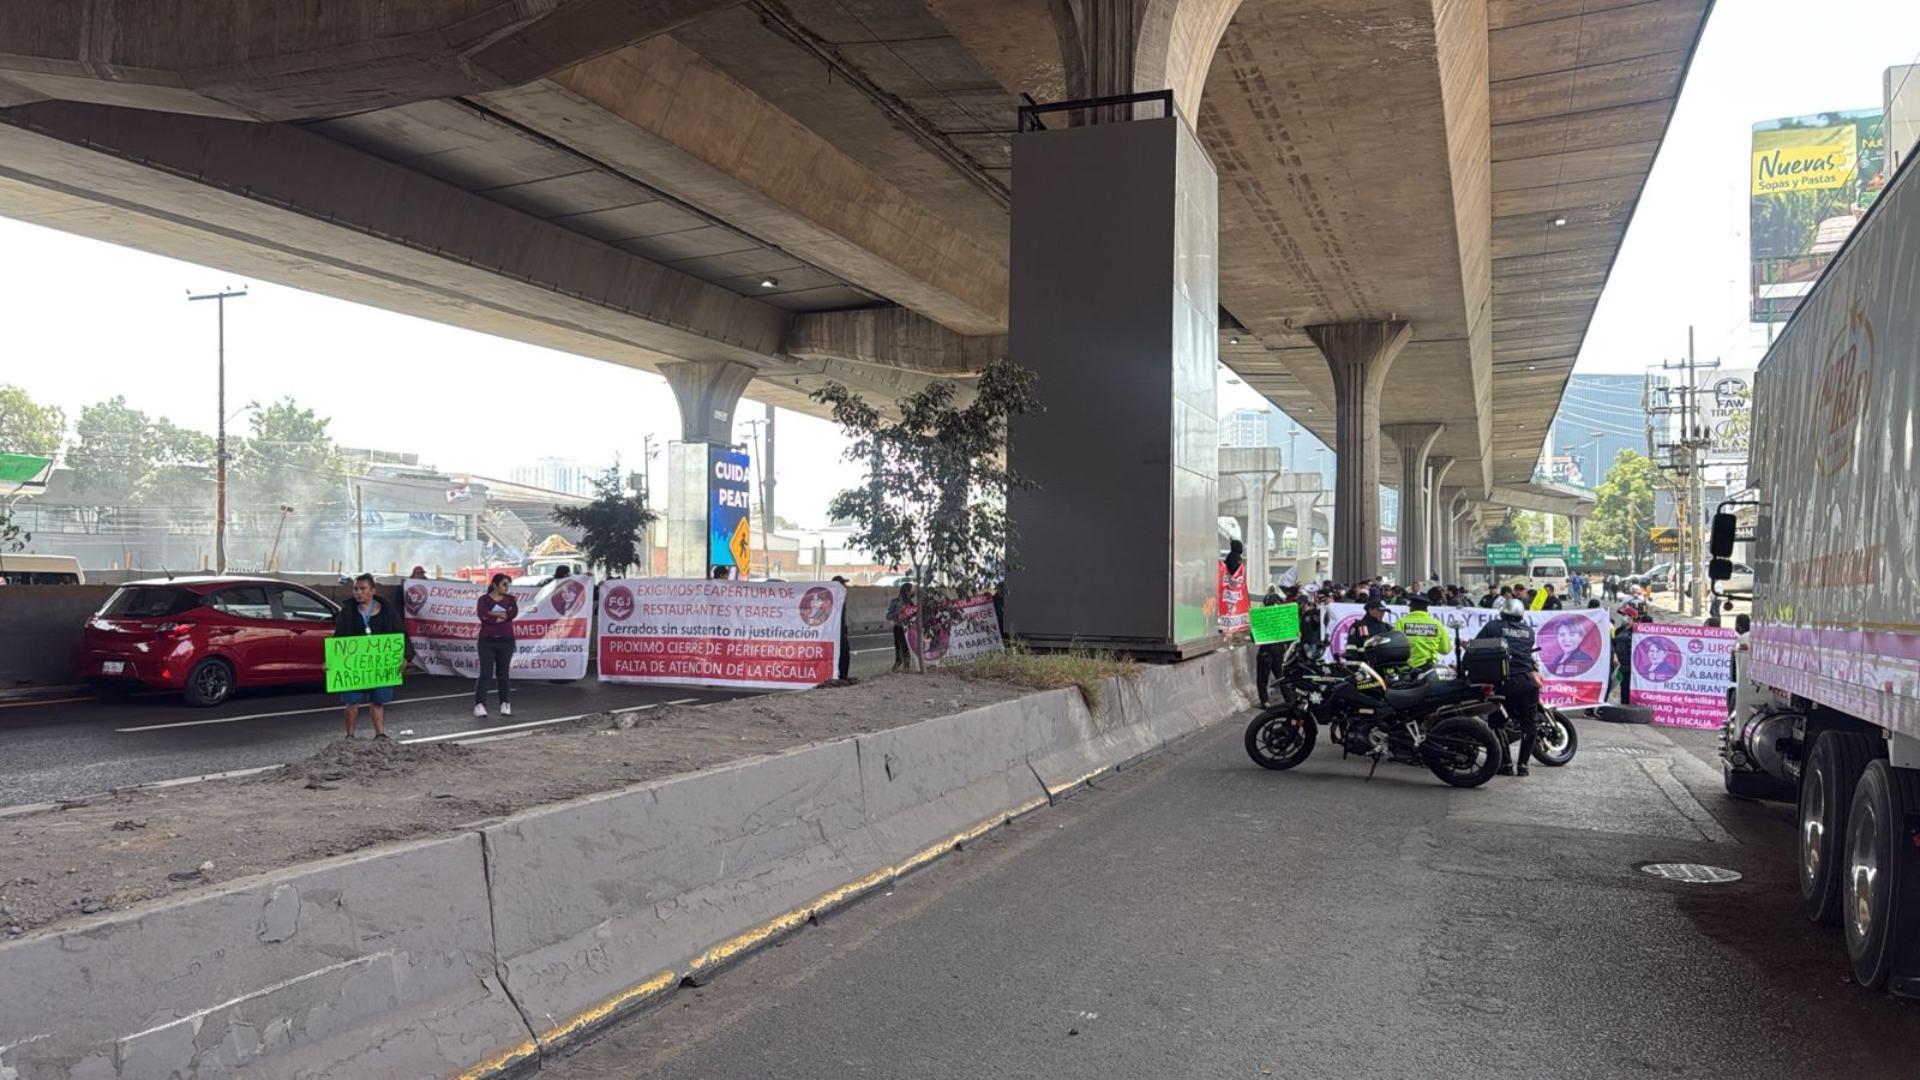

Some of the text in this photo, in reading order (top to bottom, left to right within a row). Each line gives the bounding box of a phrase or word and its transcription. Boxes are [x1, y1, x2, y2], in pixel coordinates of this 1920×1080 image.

[1758, 150, 1836, 181] Nuevas
[1758, 174, 1836, 191] Sopas y Pastas
[1717, 399, 1746, 409] FAW
[637, 584, 796, 599] EXIGIMOS REAPERTURA DE
[608, 596, 632, 607] FGJ
[642, 603, 784, 619] RESTAURANTES Y BARES
[607, 622, 820, 640] Cerrados sin sustento ni justificación
[1637, 625, 1703, 637] GOBERNADORA
[334, 639, 359, 656] NO
[366, 636, 404, 654] MAS
[609, 641, 824, 659] PROXIMO CIERRE DE PERIFERICO POR
[1707, 642, 1733, 654] URG
[344, 652, 402, 671] CIERRES
[531, 658, 567, 670] ESTADO
[615, 659, 648, 673] FALTA
[650, 660, 666, 673] DE
[726, 663, 745, 676] DE
[747, 664, 763, 677] LA
[1663, 681, 1728, 694] RESTAURANT
[1640, 692, 1671, 702] Cientos
[1672, 694, 1682, 703] de
[1684, 695, 1716, 706] familias
[1674, 707, 1688, 716] por
[1667, 716, 1675, 724] la
[1676, 716, 1713, 728] FISCALIA
